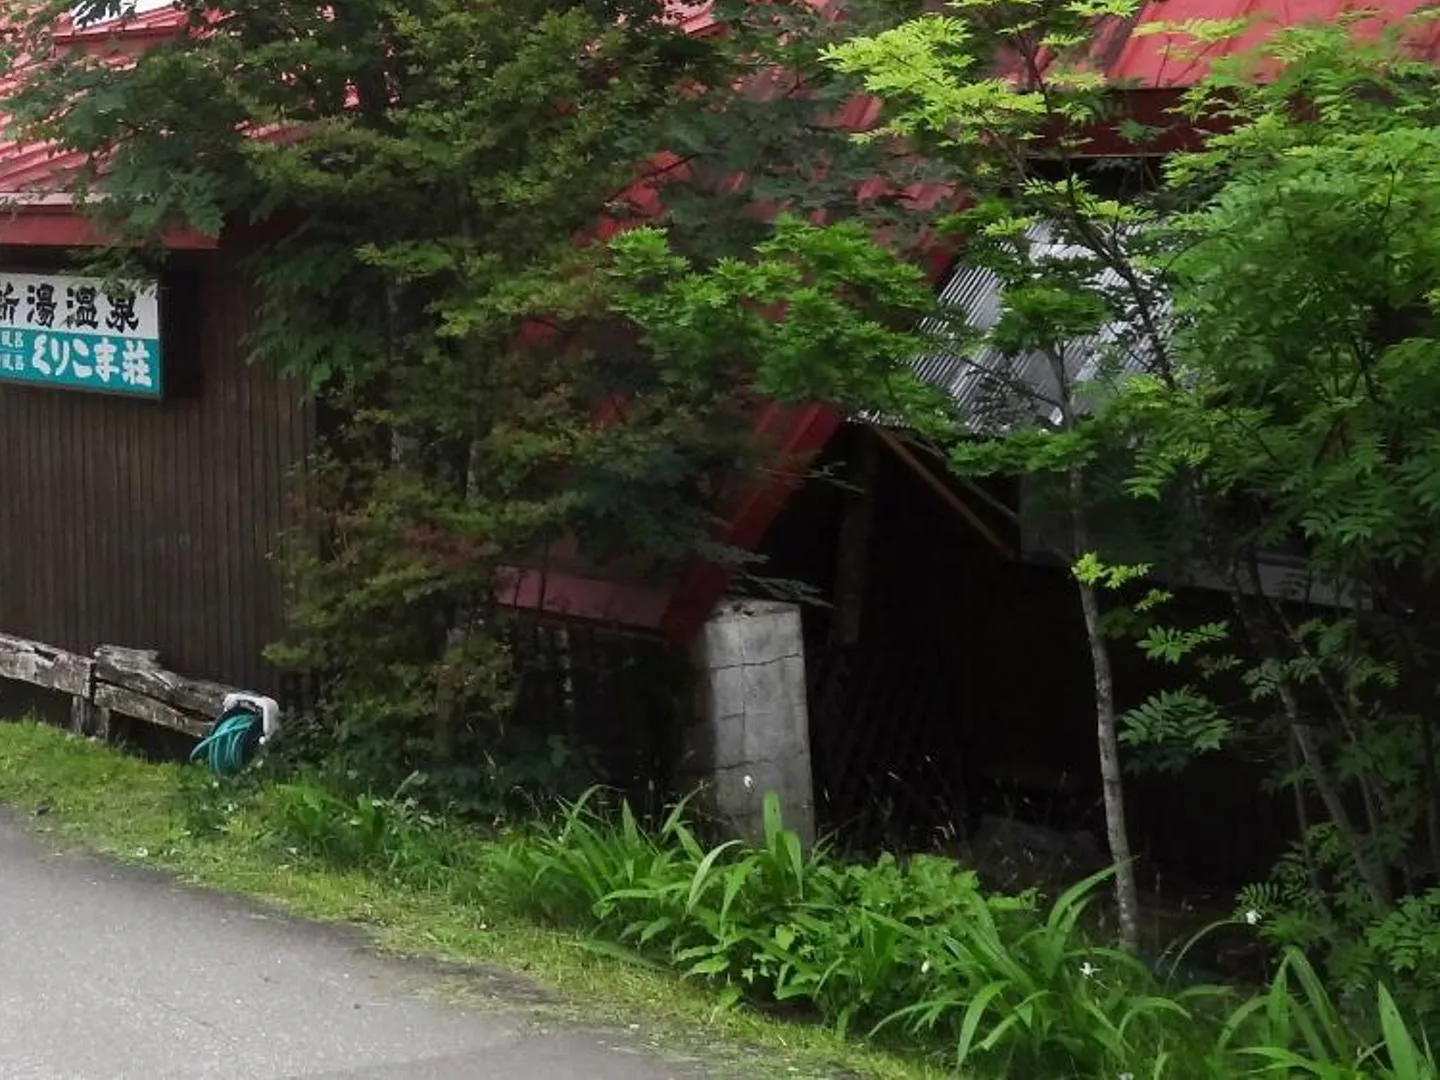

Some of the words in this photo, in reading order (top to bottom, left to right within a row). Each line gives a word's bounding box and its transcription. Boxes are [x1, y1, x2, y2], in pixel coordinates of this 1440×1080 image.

[31, 333, 153, 388] くりこま荘
